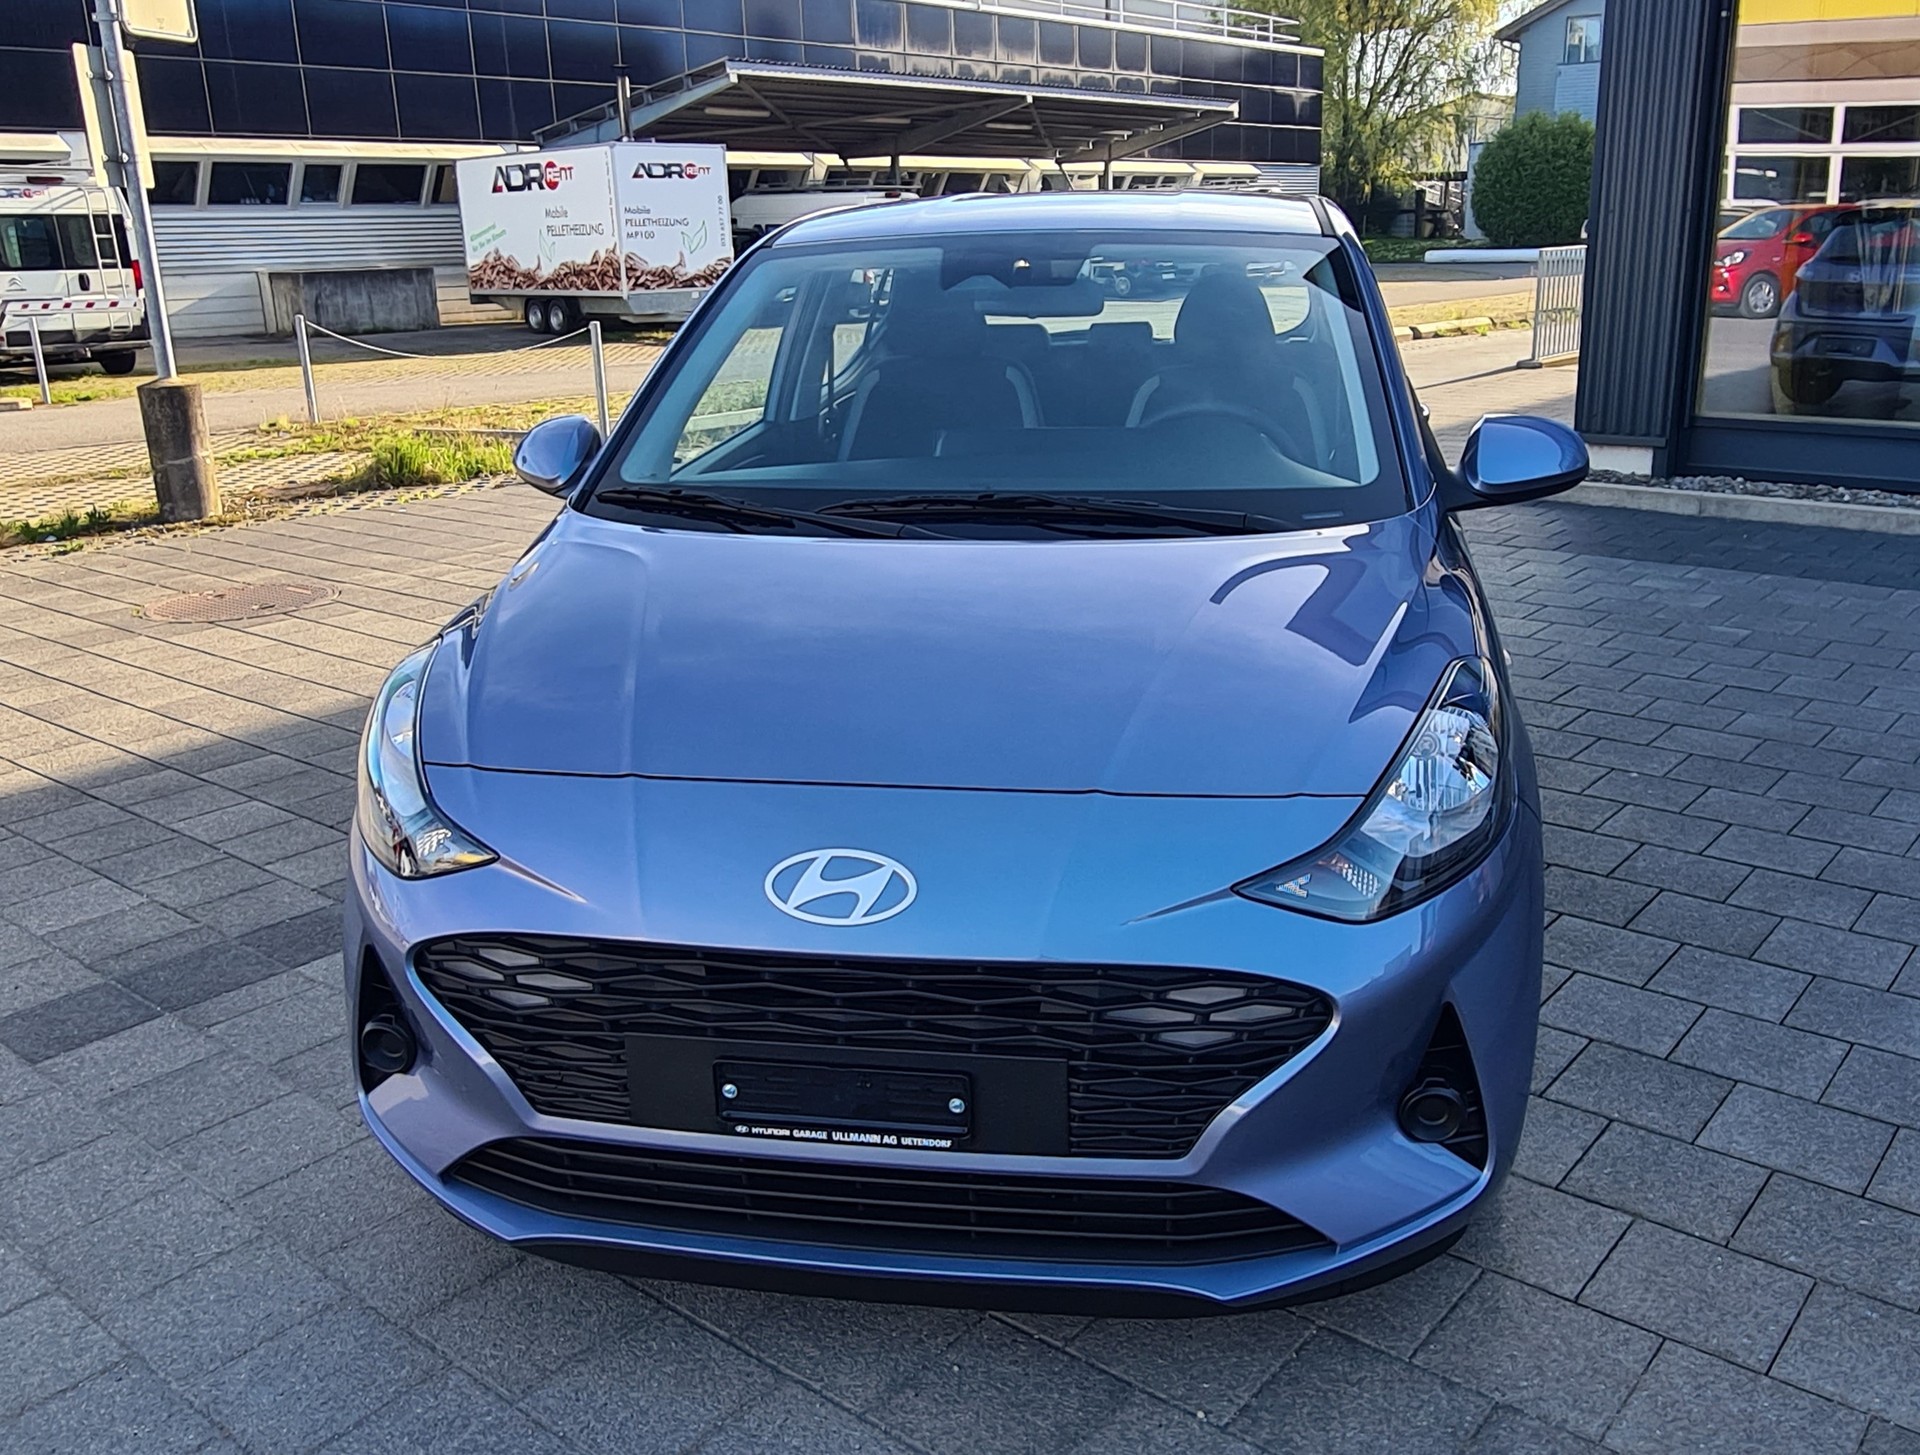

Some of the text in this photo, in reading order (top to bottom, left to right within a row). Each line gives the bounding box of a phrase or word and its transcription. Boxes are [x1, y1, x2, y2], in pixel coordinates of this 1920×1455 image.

[545, 206, 568, 218] Mobile
[624, 205, 651, 215] Mobile
[625, 217, 689, 227] PELLETHEIZUNG
[546, 222, 604, 237] PELLETHEIZUNG
[626, 230, 655, 240] MP100
[751, 1126, 952, 1148] HYUNDAI GARAGE ULLMANN AG UETENDORF
